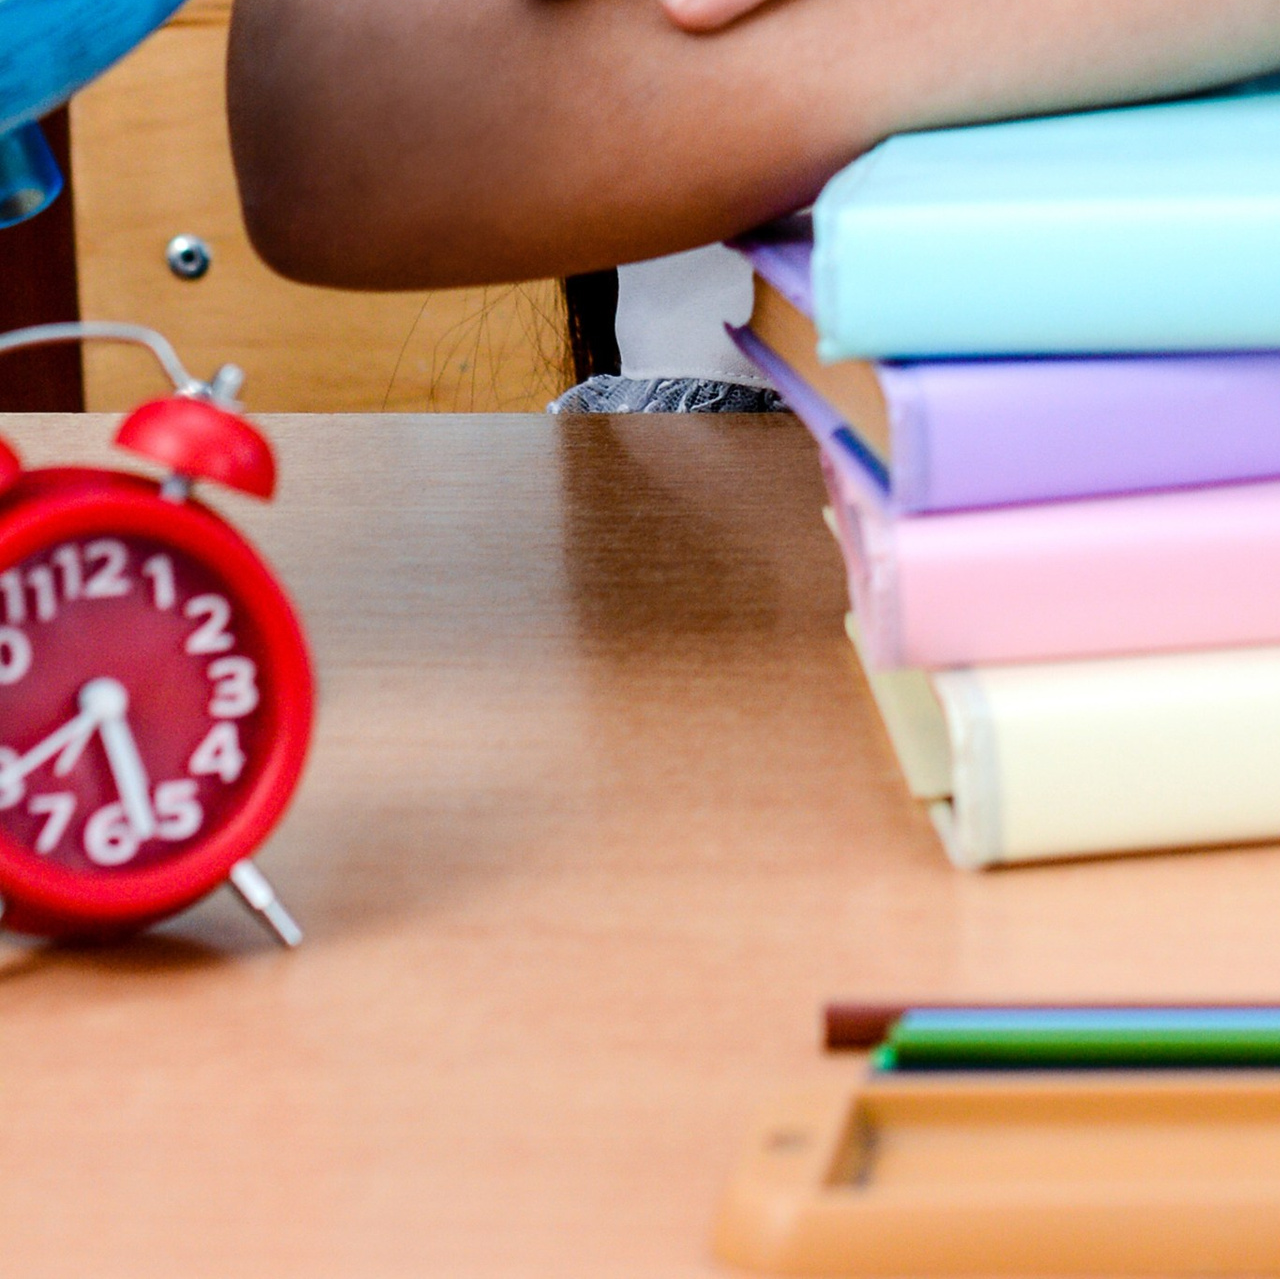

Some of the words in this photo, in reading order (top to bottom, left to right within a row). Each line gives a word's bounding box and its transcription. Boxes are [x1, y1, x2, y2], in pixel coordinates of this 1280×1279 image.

[54, 539, 131, 600] 12
[143, 553, 175, 611] 1
[185, 594, 235, 655] 2
[208, 655, 257, 718] 3
[189, 721, 246, 784] 4
[28, 792, 76, 854] 7
[84, 800, 142, 866] 6
[155, 778, 203, 841] 5
